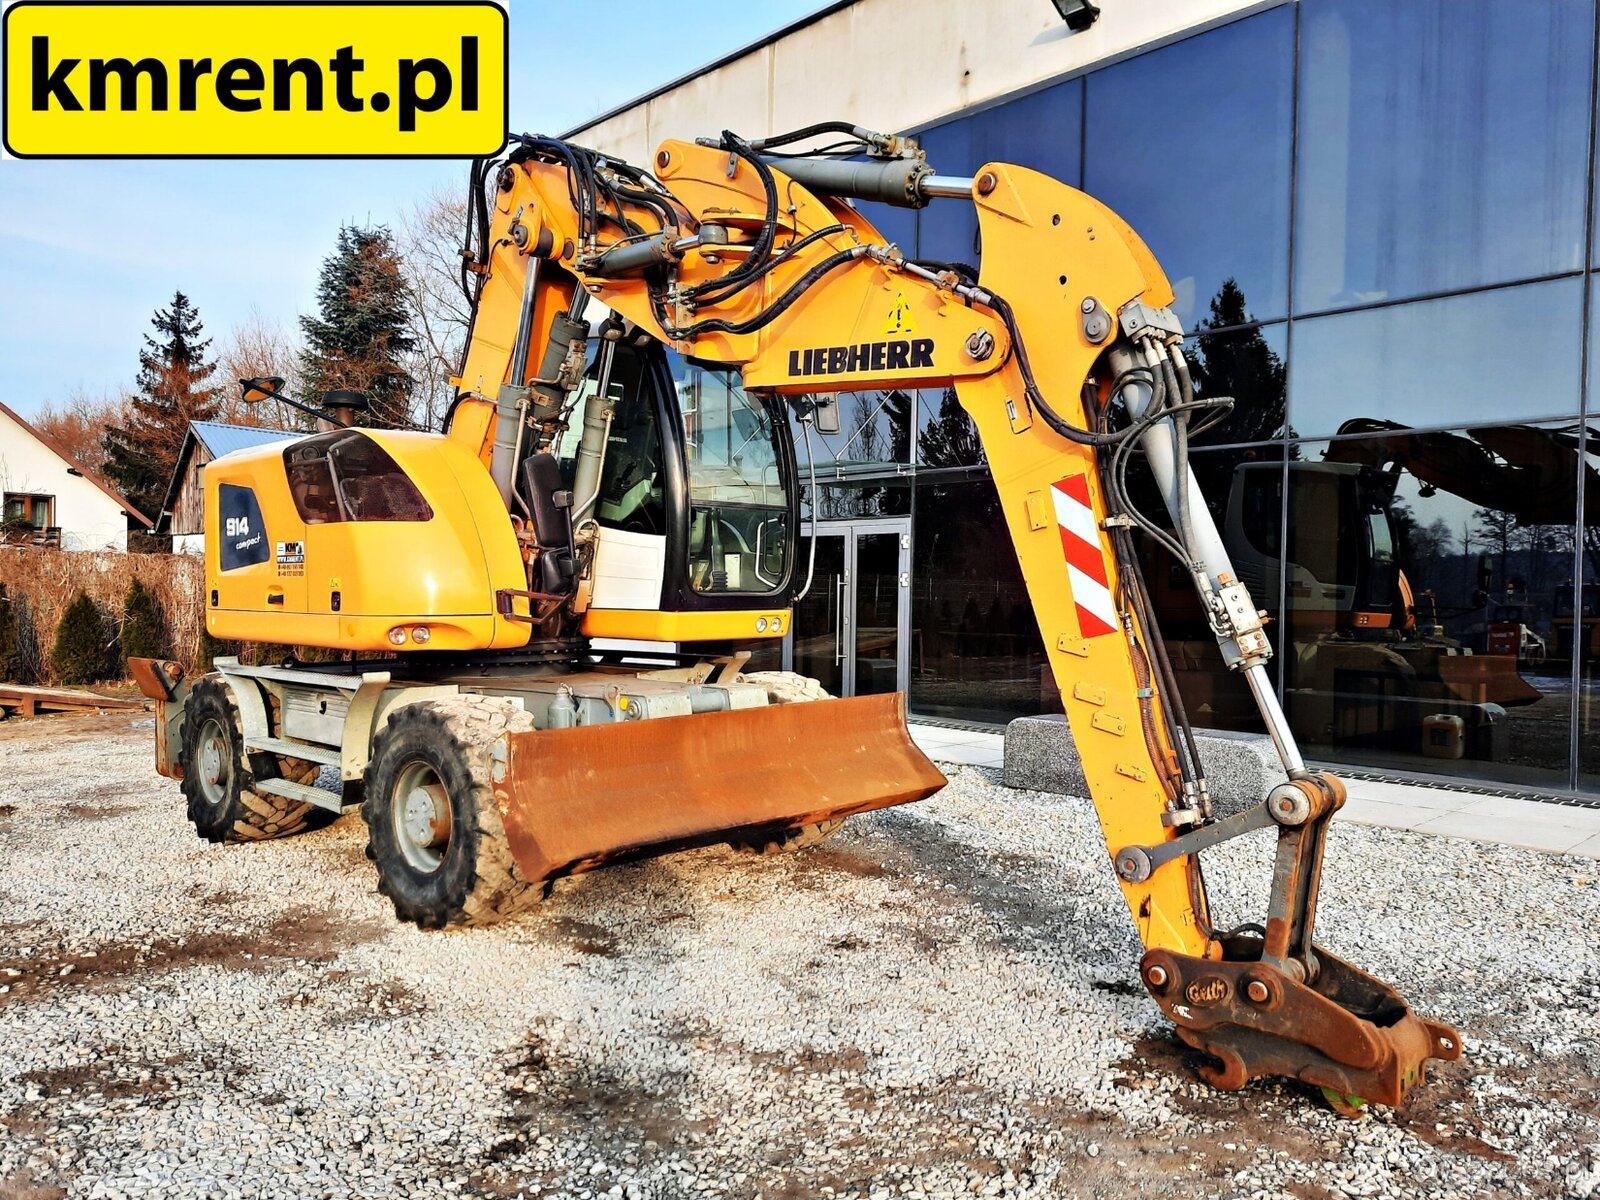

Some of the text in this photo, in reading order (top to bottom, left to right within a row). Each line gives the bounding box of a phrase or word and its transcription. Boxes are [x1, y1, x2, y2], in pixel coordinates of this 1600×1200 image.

[787, 338, 935, 376] LIEBHERR
[226, 516, 249, 536] 914
[236, 531, 260, 550] compact
